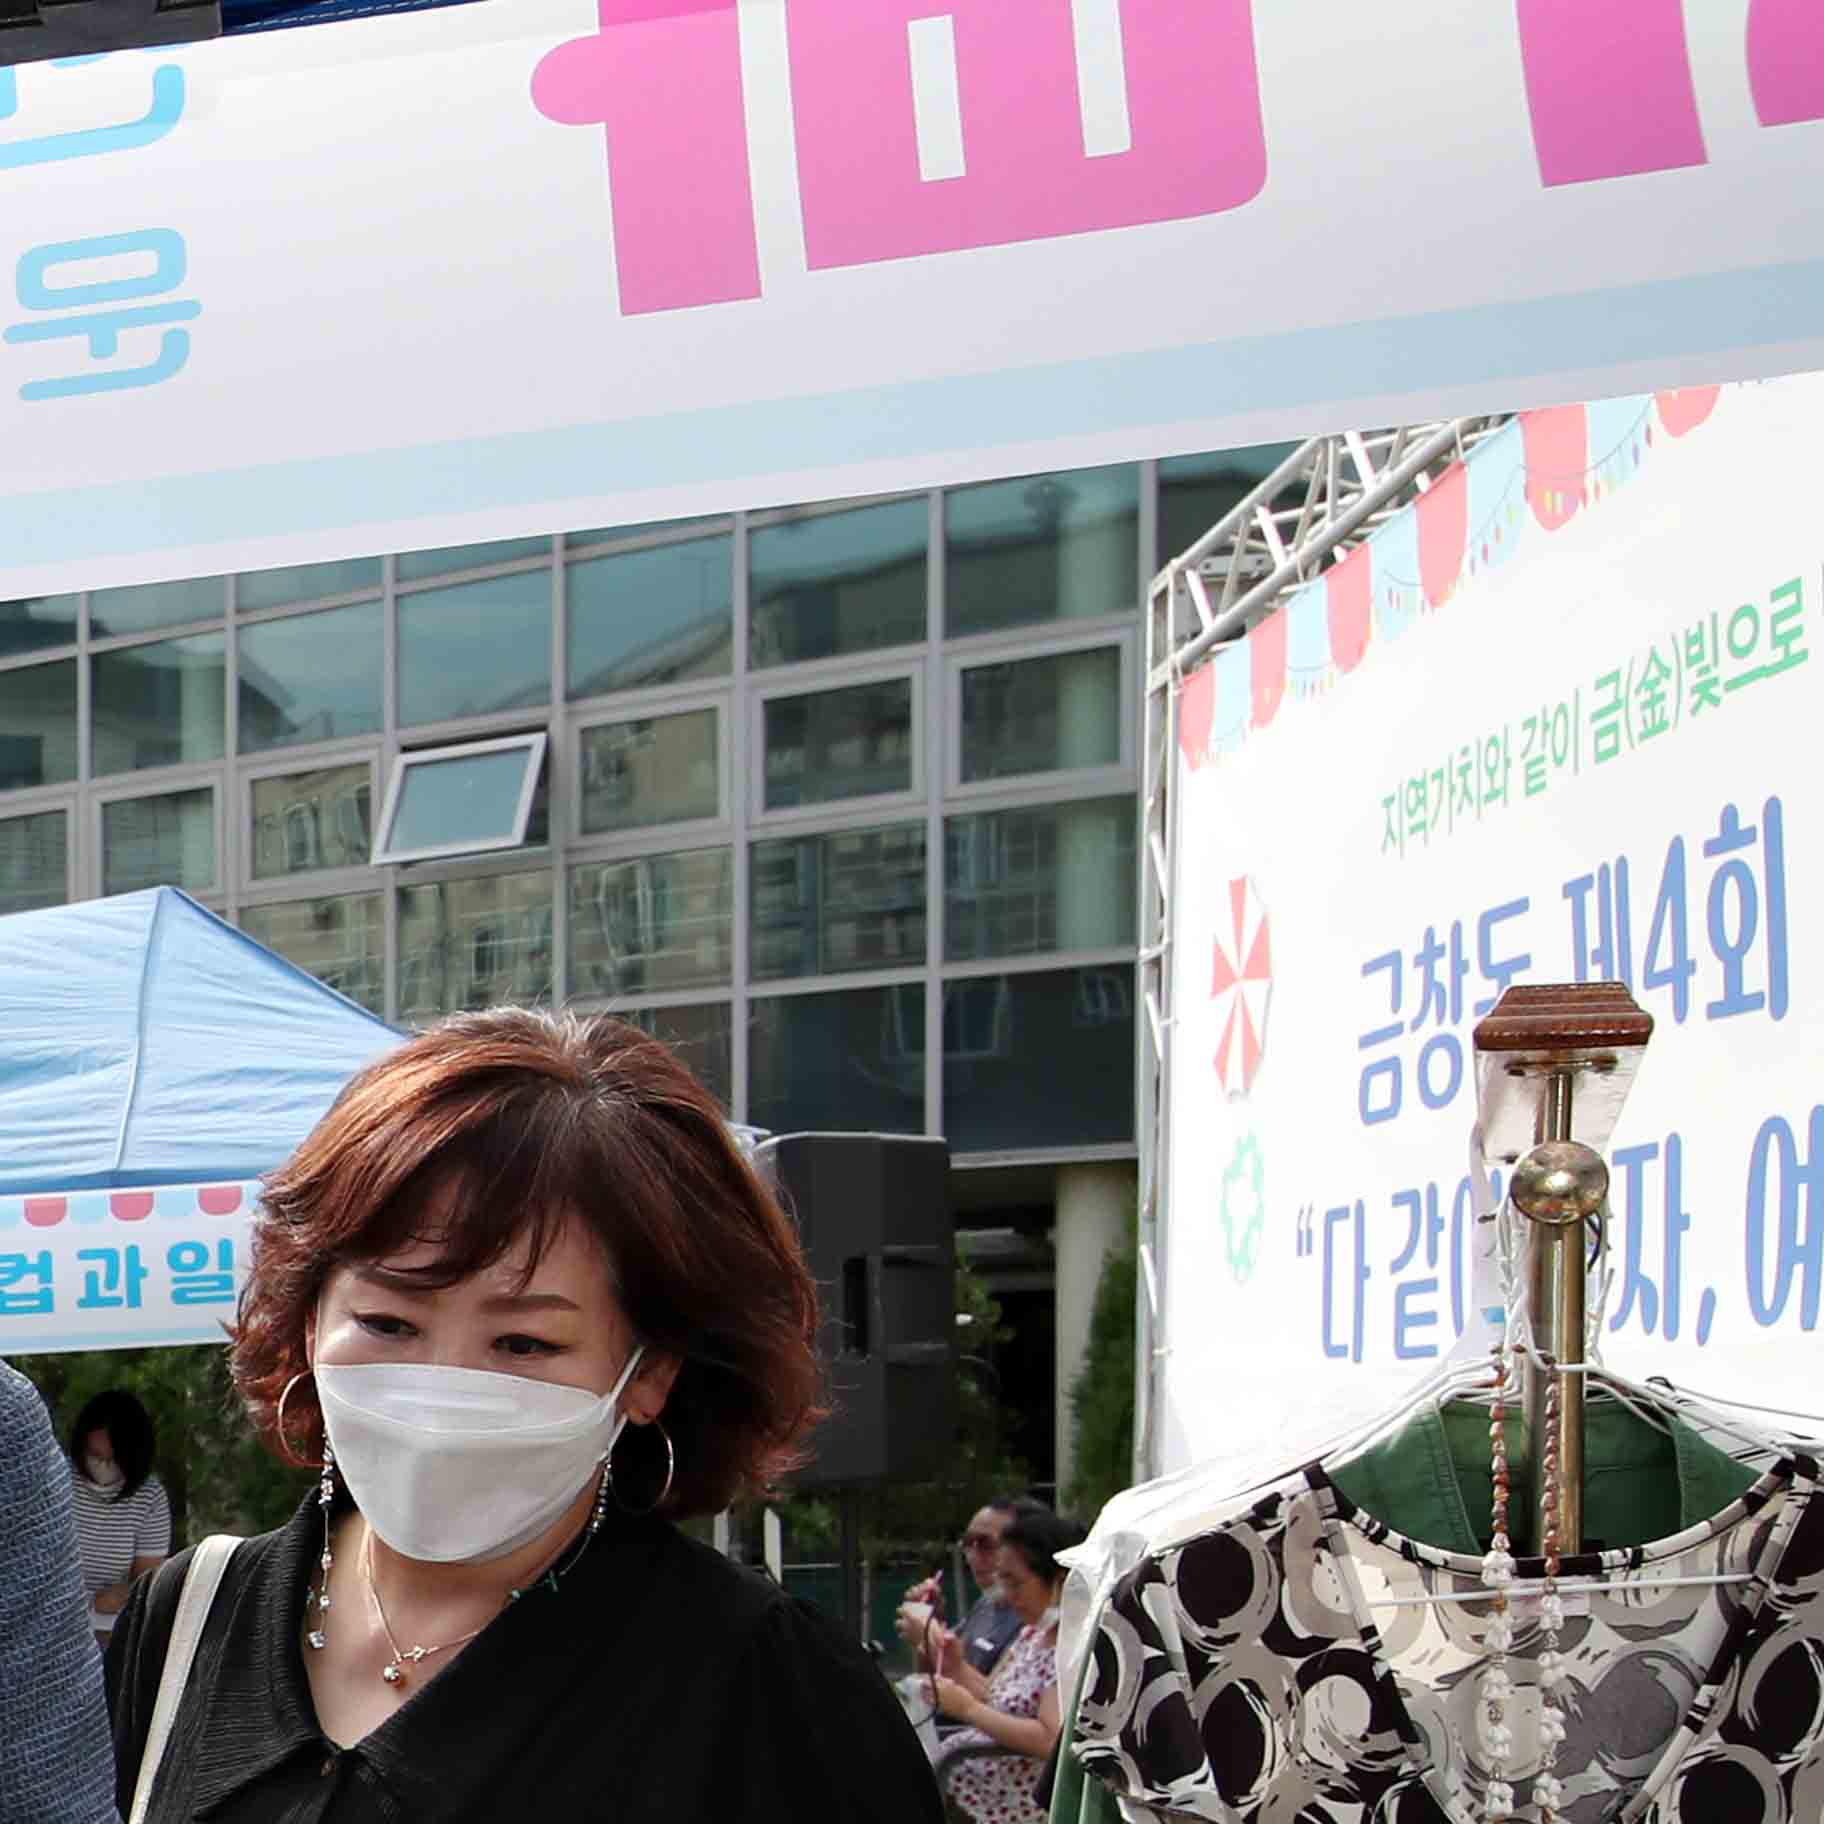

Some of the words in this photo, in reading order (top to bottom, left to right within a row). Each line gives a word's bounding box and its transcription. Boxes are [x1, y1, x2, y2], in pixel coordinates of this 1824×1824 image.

[1381, 725, 1511, 859] 지역가치와
[1521, 687, 1580, 798] 같이
[1562, 795, 1789, 1025] 제4회
